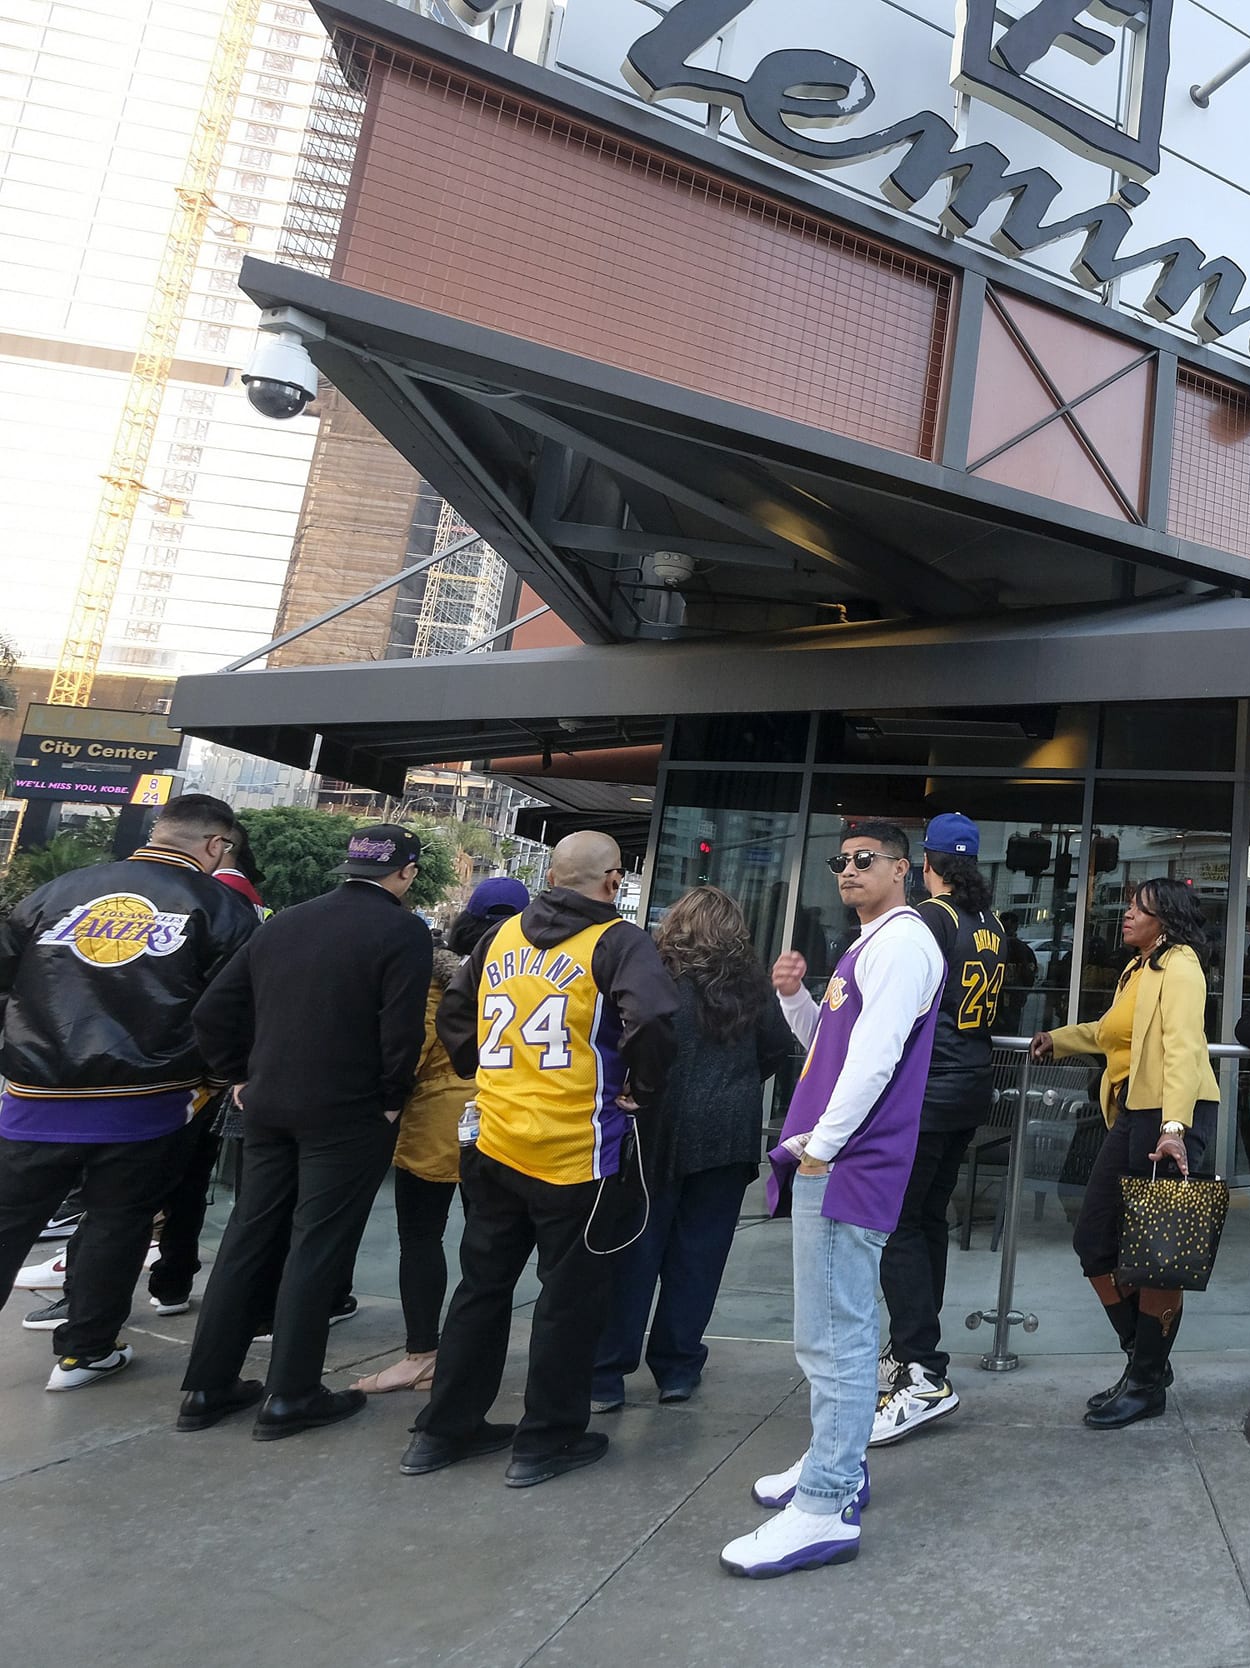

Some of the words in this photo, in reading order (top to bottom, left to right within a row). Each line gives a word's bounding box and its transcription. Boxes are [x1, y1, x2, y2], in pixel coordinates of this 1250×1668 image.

[39, 739, 83, 758] City
[87, 743, 158, 761] Center
[16, 779, 46, 789] WE'LL
[48, 782, 72, 791] MISS
[74, 783, 98, 793] YOU,
[100, 785, 130, 795] KOBE.
[149, 778, 158, 790] 8
[142, 792, 159, 805] 24
[100, 910, 128, 918] LOS
[128, 912, 185, 924] ANGELES
[55, 909, 180, 953] LAKERS
[973, 929, 1001, 955] BRYANT
[485, 946, 586, 991] BRYANT
[958, 960, 1005, 1030] 24
[479, 994, 572, 1071] 24
